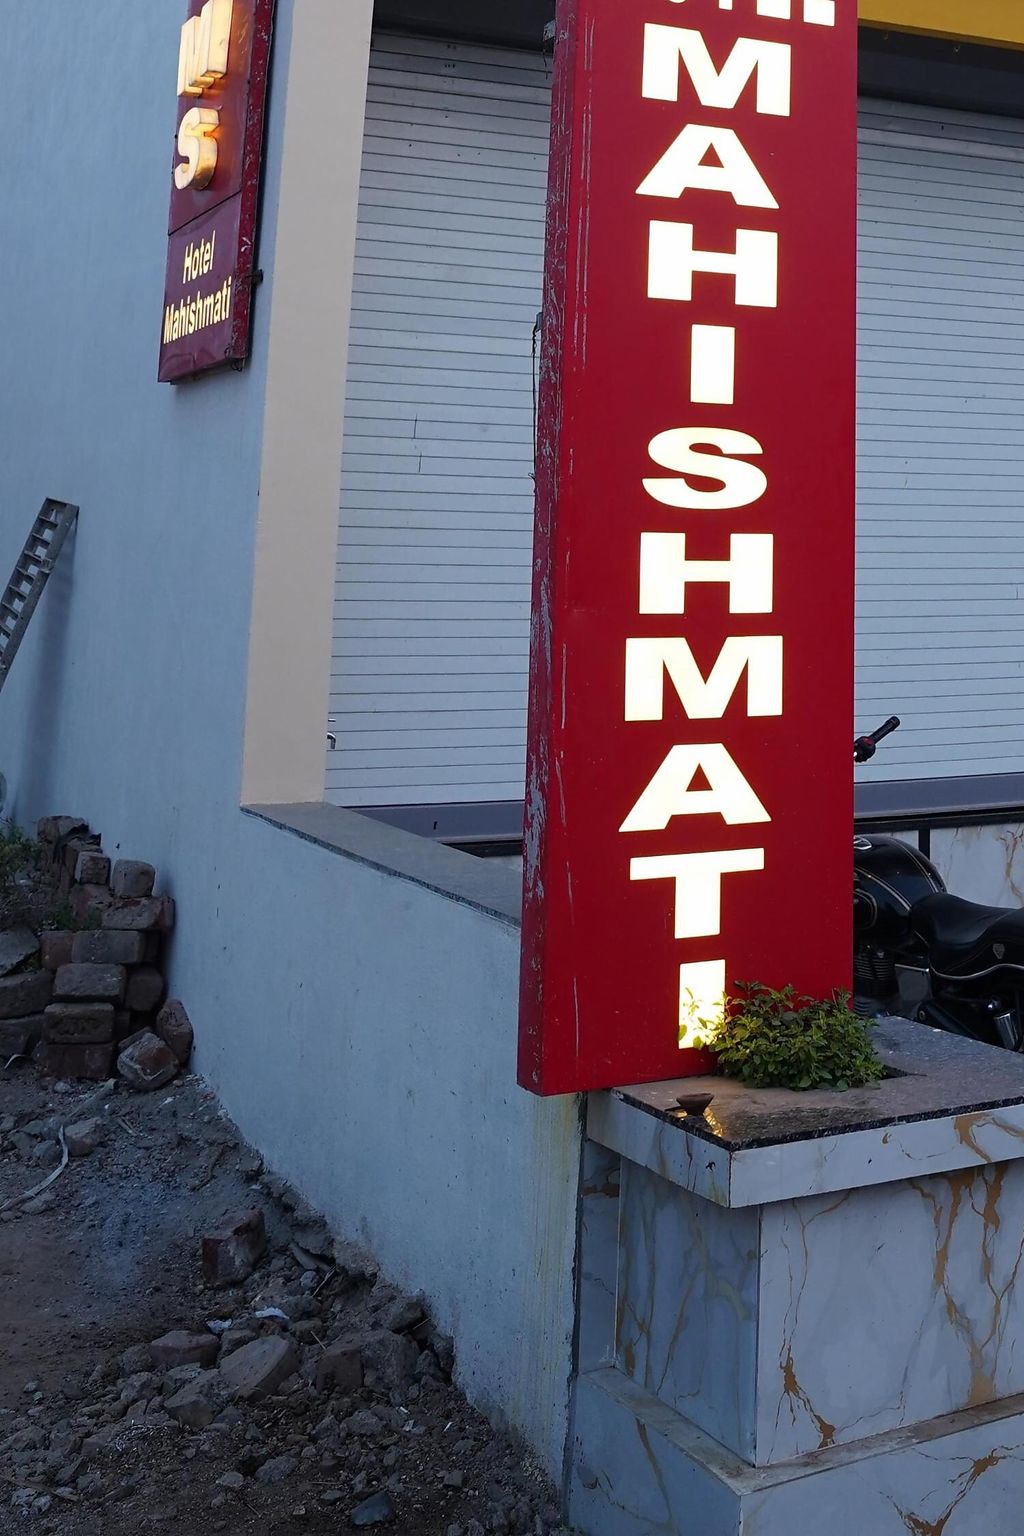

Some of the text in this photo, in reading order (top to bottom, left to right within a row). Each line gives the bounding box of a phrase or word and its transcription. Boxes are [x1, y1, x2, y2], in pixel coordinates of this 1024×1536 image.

[182, 230, 216, 284] Hotel
[163, 276, 231, 344] Mahishmati
[618, 22, 792, 1050] MAHISHMATI
